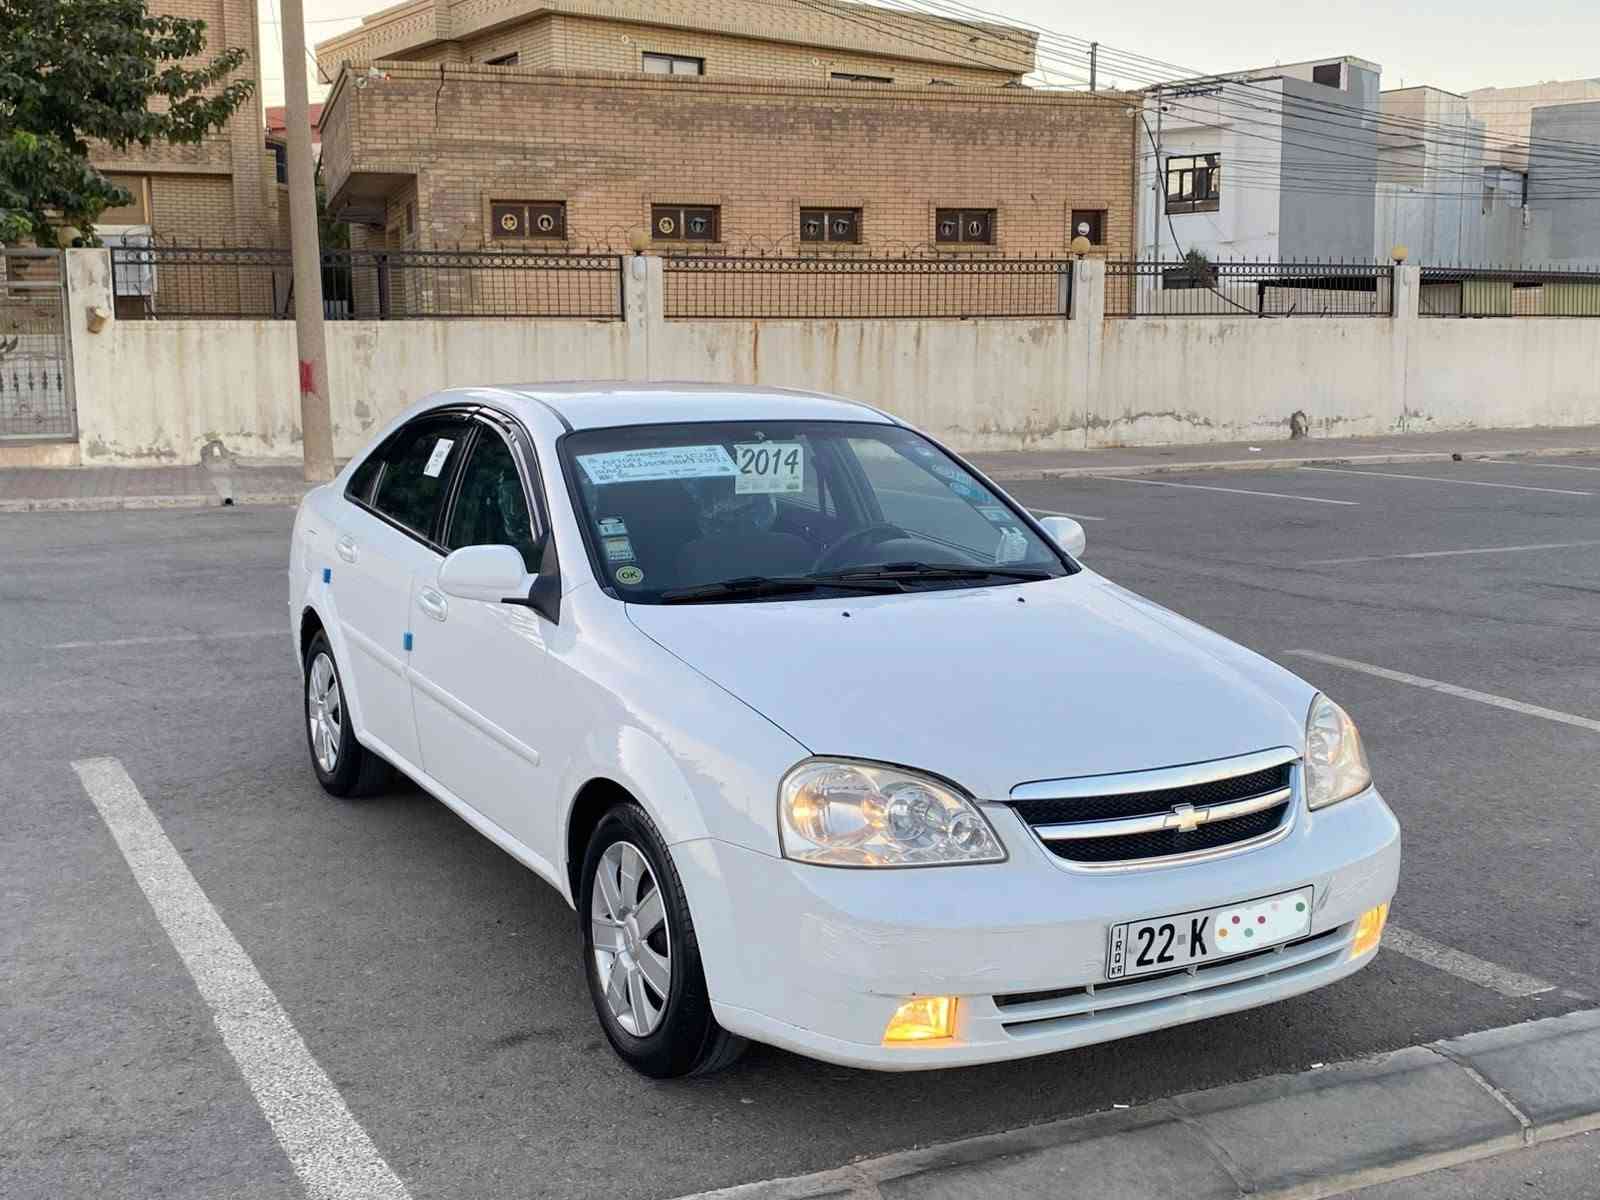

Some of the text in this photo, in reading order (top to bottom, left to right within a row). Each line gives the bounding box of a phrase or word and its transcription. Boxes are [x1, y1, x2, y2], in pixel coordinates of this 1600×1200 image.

[740, 448, 799, 475] 2014
[621, 570, 638, 579] OK
[1136, 916, 1209, 967] 22 K
